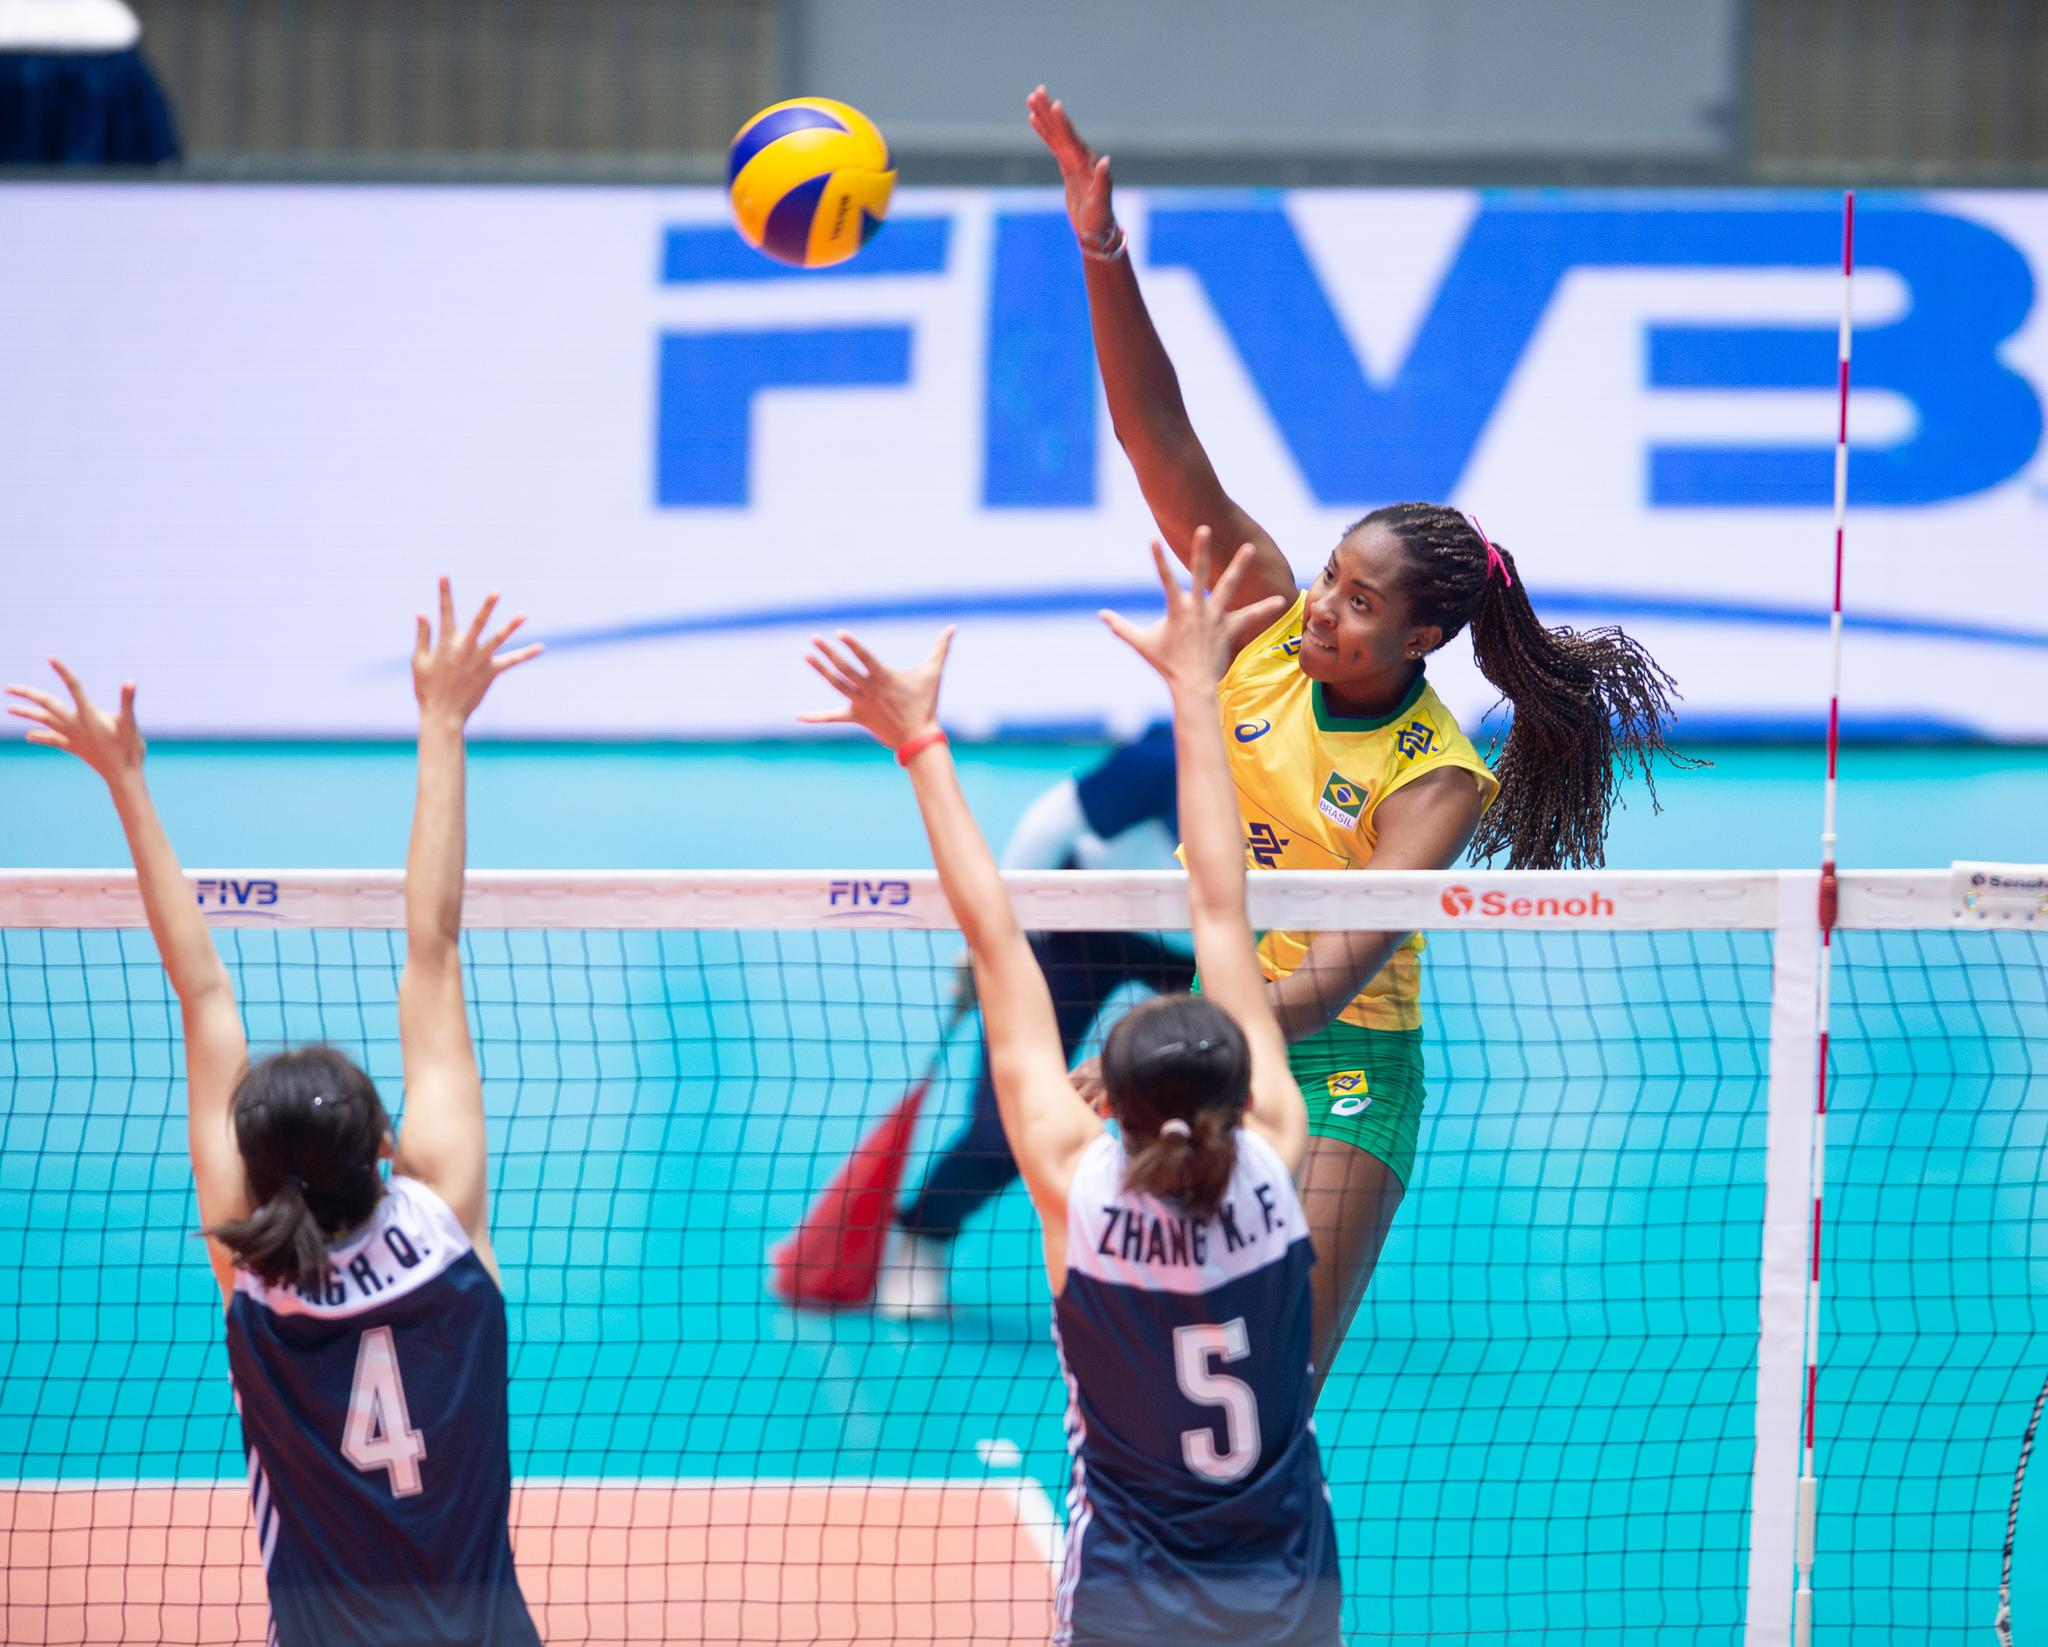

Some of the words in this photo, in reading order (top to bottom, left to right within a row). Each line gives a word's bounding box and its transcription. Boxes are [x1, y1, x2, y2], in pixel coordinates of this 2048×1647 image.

[656, 188, 2043, 508] FIVB
[1318, 799, 1353, 829] BRASIL
[197, 879, 279, 905] FIVB
[830, 880, 910, 906] FIVB
[1480, 890, 1615, 917] Senoh
[1097, 1206, 1210, 1268] ZHANG
[339, 1325, 428, 1500] 4
[1172, 1315, 1263, 1486] 5
